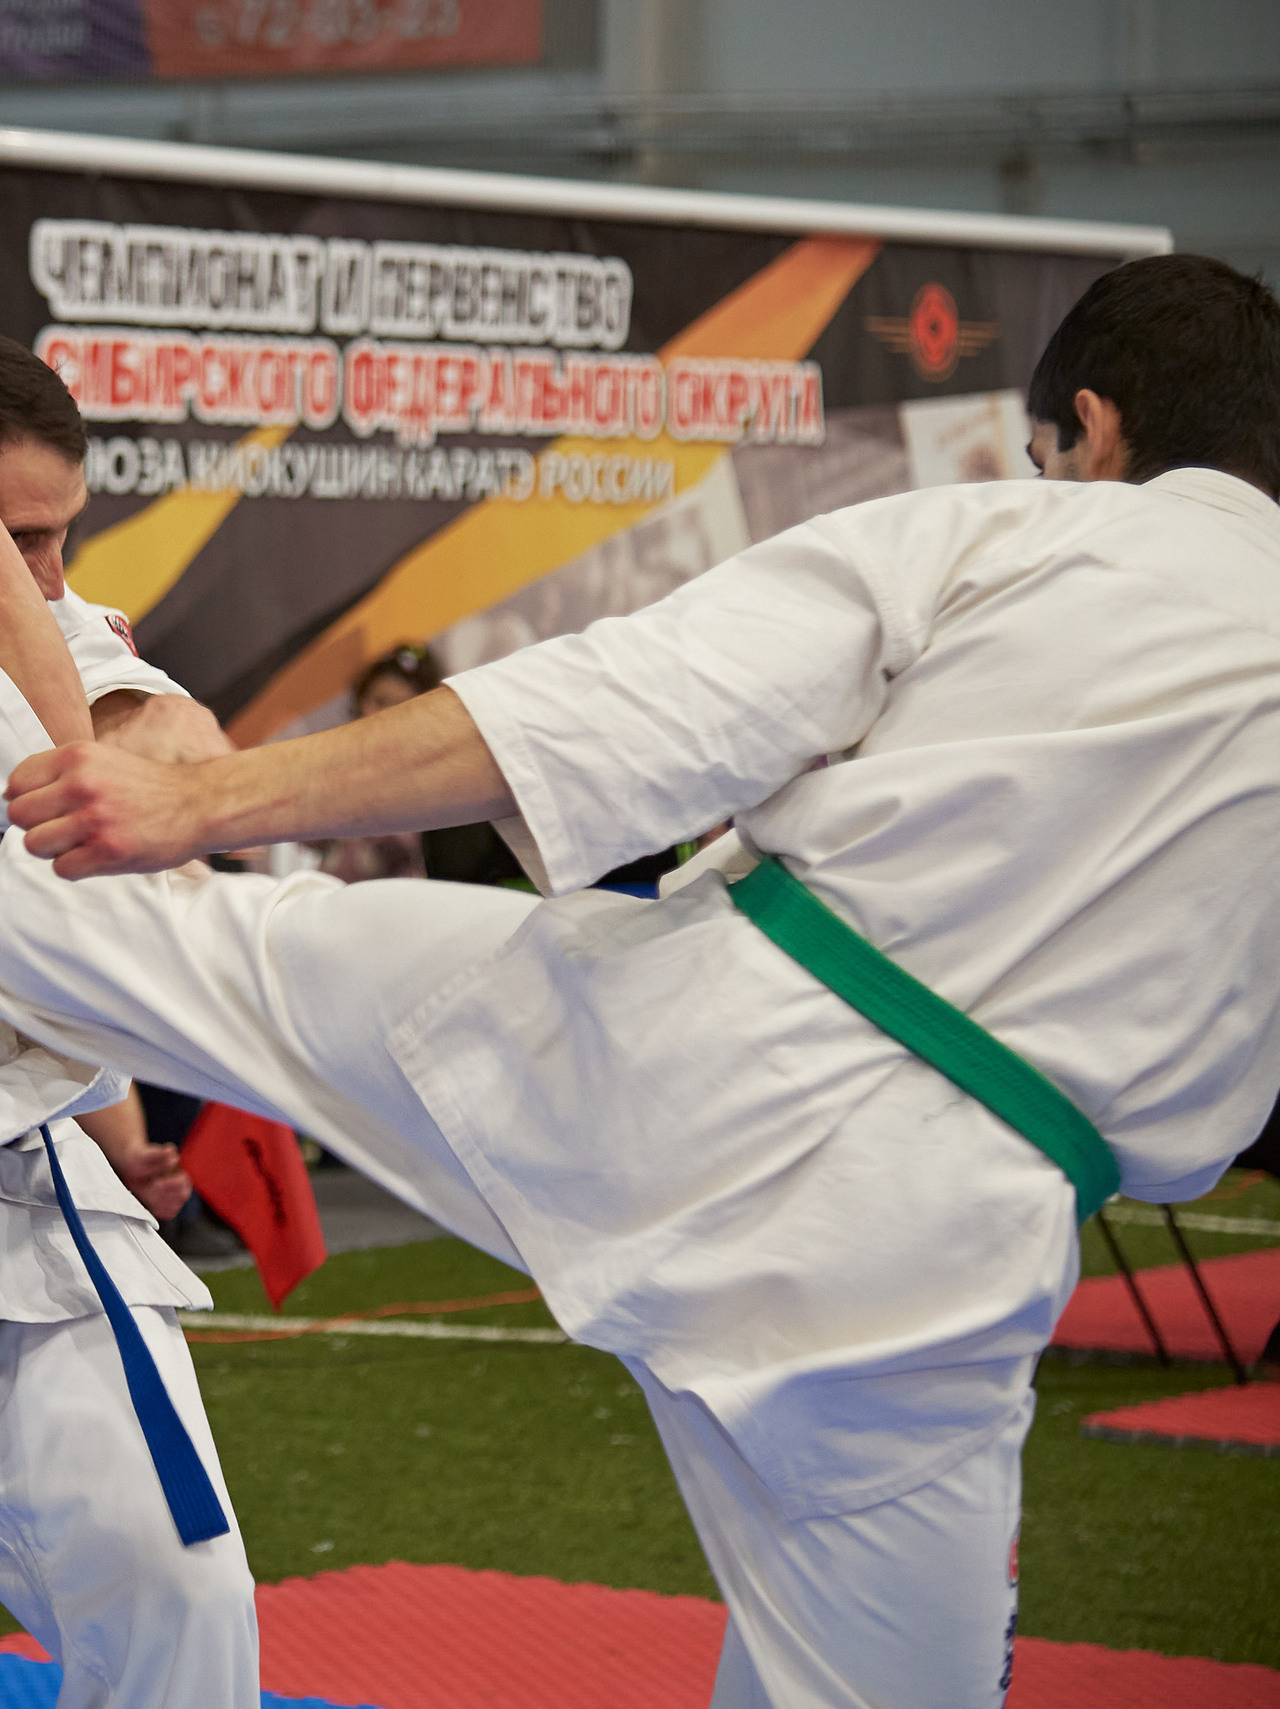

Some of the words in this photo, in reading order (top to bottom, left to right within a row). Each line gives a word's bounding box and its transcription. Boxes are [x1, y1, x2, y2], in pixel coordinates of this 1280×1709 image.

[34, 223, 319, 328] ЧЕМПИОНАТ
[325, 246, 367, 330] И
[372, 245, 631, 344] ПЕРВЕНСТВО
[346, 344, 662, 440] ФЕДЕРАЛЬНОГО
[668, 361, 822, 440] ОКРУГА
[86, 438, 184, 494] ЮЗА
[190, 442, 402, 498] КИОКУШИН
[406, 447, 536, 500] КАРАТЭ
[539, 452, 675, 503] РОССИИ
